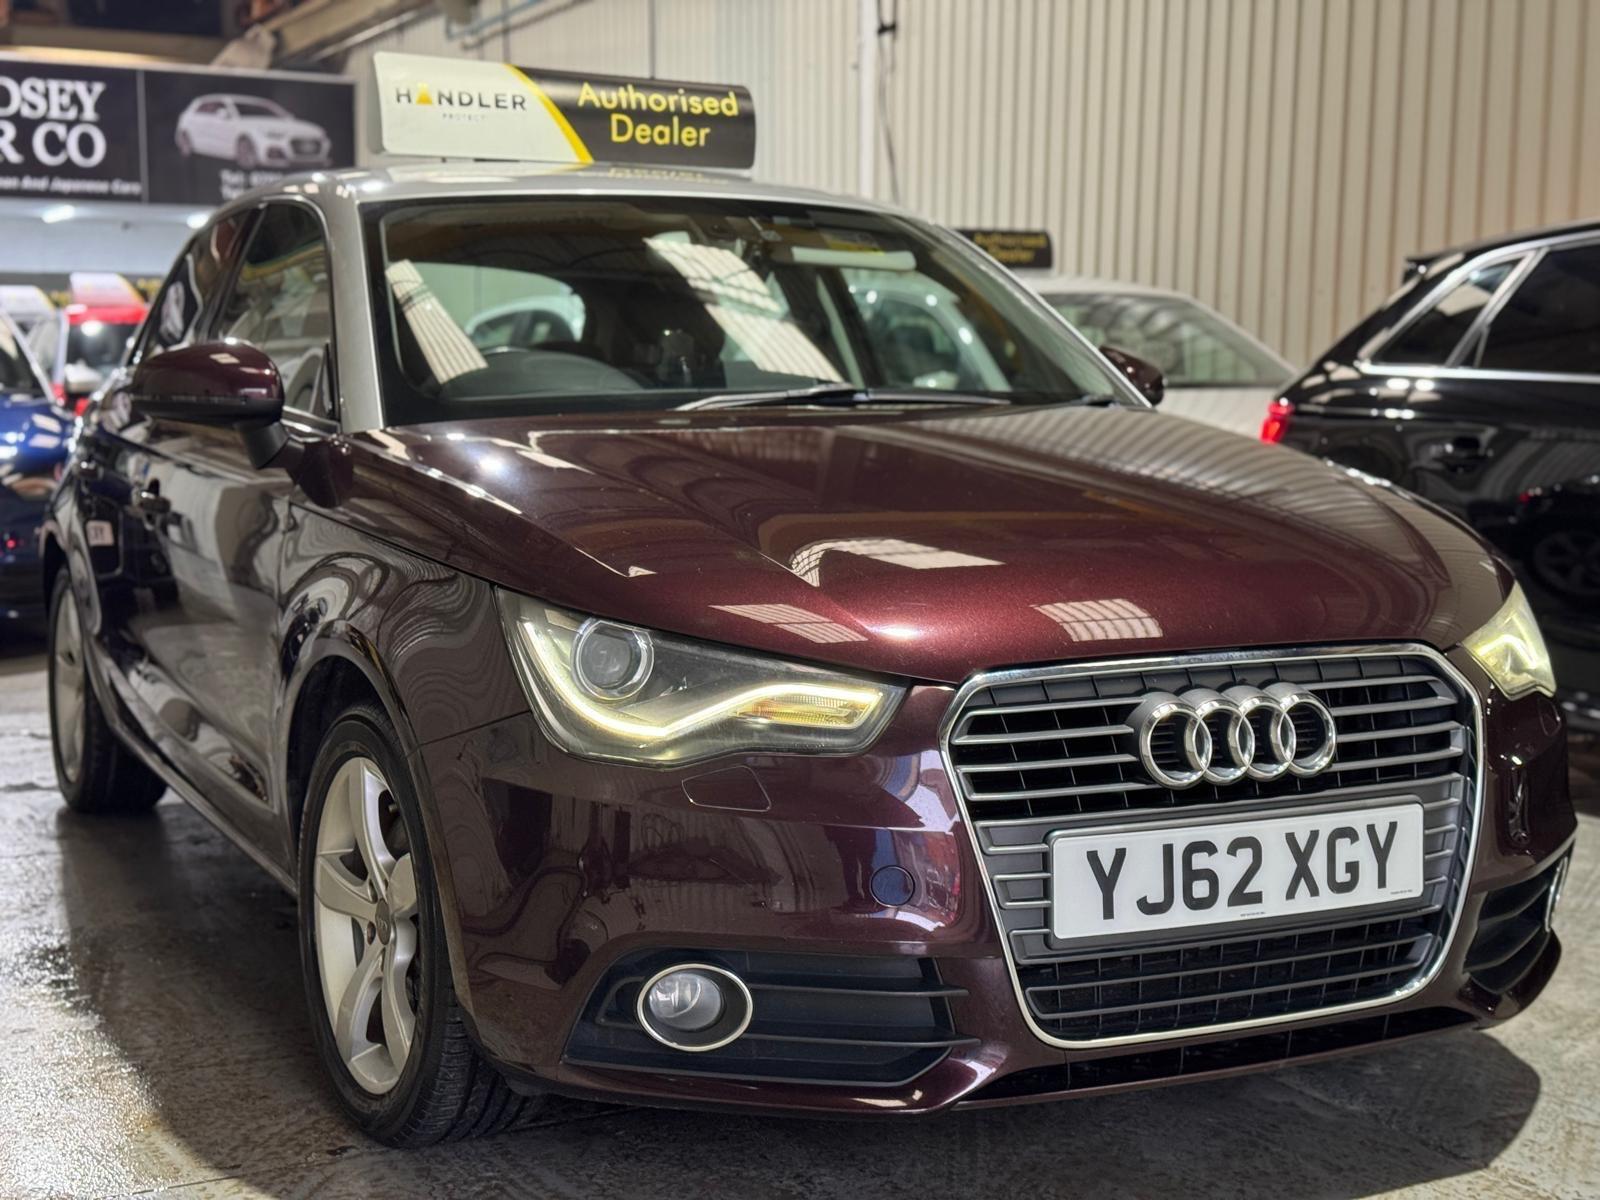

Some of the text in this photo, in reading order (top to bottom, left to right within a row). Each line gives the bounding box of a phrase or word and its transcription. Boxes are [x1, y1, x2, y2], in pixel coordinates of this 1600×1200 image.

[577, 81, 739, 117] Authorised
[32, 121, 107, 168] CO
[610, 112, 711, 147] Dealer
[1086, 820, 1398, 921] YJ62 XGY
